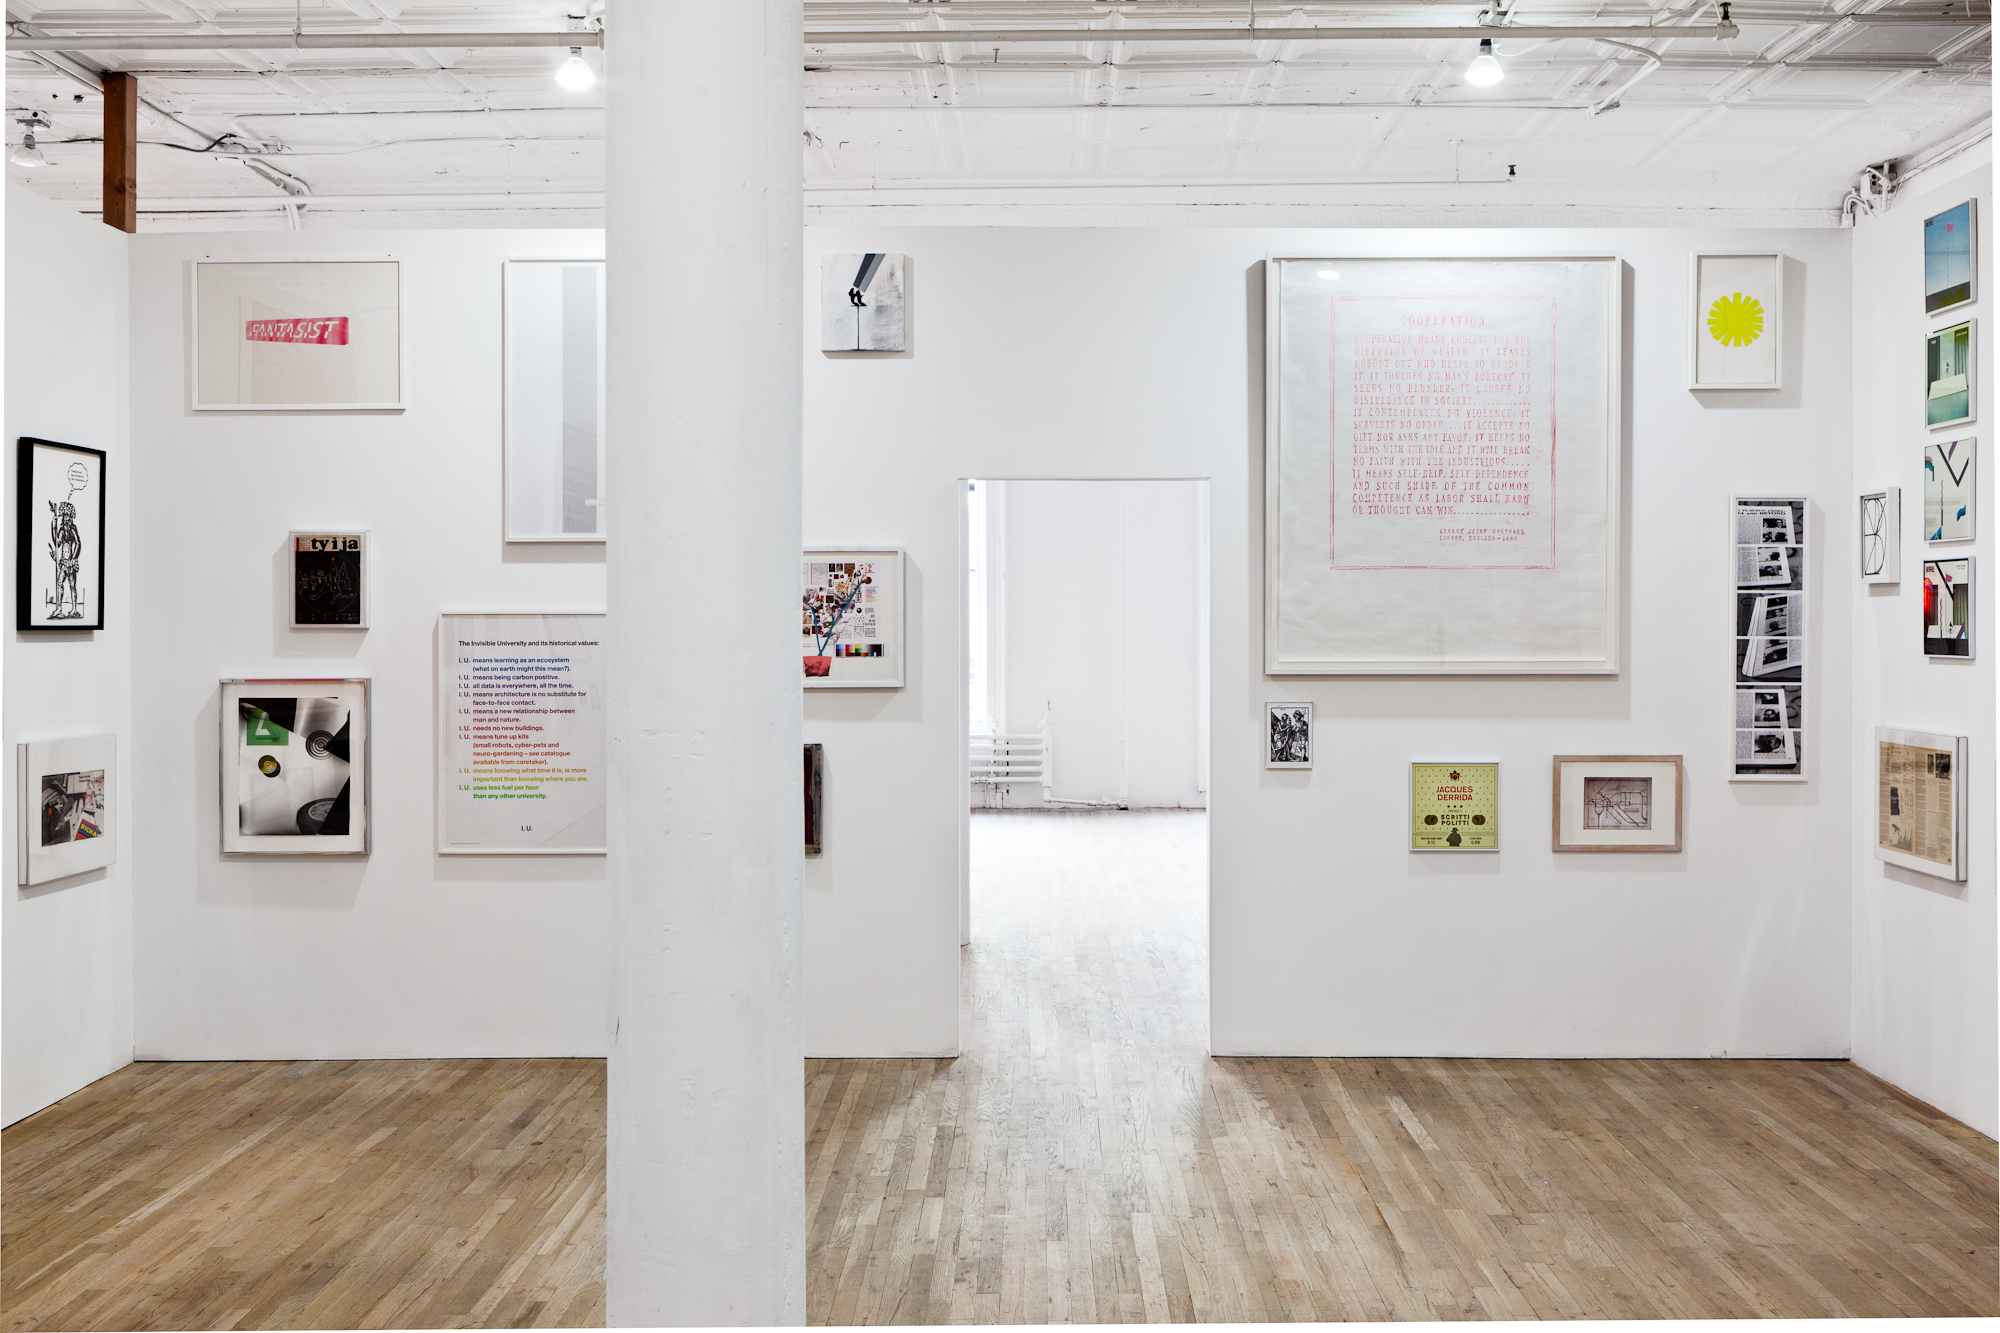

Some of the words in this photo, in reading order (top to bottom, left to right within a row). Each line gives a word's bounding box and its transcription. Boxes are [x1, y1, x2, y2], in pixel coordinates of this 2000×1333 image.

[1401, 316, 1485, 326] COOPERATION
[249, 321, 339, 339] FANTASIST
[1354, 335, 1412, 344] COOPERATION
[1417, 335, 1445, 344] MEANS
[1493, 335, 1509, 344] FOR
[1515, 336, 1531, 344] THE
[1355, 347, 1406, 356] DIFFUSION
[1413, 347, 1424, 356] OF
[1481, 347, 1489, 356] IT
[1497, 347, 1530, 356] LEAVES
[1354, 359, 1389, 368] NOBODY
[1394, 359, 1411, 368] OUT
[1416, 359, 1435, 368] WHO
[1441, 359, 1468, 368] HELPS
[1475, 360, 1484, 368] TO
[1491, 360, 1530, 368] PRODUCE
[1370, 372, 1378, 380] IT
[1384, 372, 1422, 380] TOUCHES
[1428, 372, 1439, 380] NO
[1522, 372, 1530, 381] IT
[1354, 384, 1382, 393] SEEKS
[1389, 384, 1400, 393] NO
[1460, 384, 1469, 393] IT
[1476, 384, 1511, 393] CAUSES
[1518, 385, 1530, 394] NO
[1353, 433, 1372, 442] GIFT
[1376, 433, 1393, 442] NOR
[1397, 433, 1418, 442] ASKS
[1475, 433, 1483, 442] IT
[1488, 433, 1514, 442] KEEPS
[1518, 434, 1530, 442] NO
[1352, 469, 1360, 478] IT
[1365, 469, 1392, 478] MEANS
[1450, 470, 1528, 478] SELF-DEPENDENCE
[1353, 481, 1369, 490] AND
[1376, 481, 1400, 490] SUCH
[1406, 482, 1437, 490] SHARE
[1444, 482, 1456, 490] OF
[1463, 482, 1480, 490] THE
[1487, 482, 1529, 491] COMMON
[1352, 494, 1412, 503] COMPETENCE
[1418, 494, 1429, 503] AS
[1435, 494, 1463, 503] LABOR
[1470, 494, 1500, 503] SHALL
